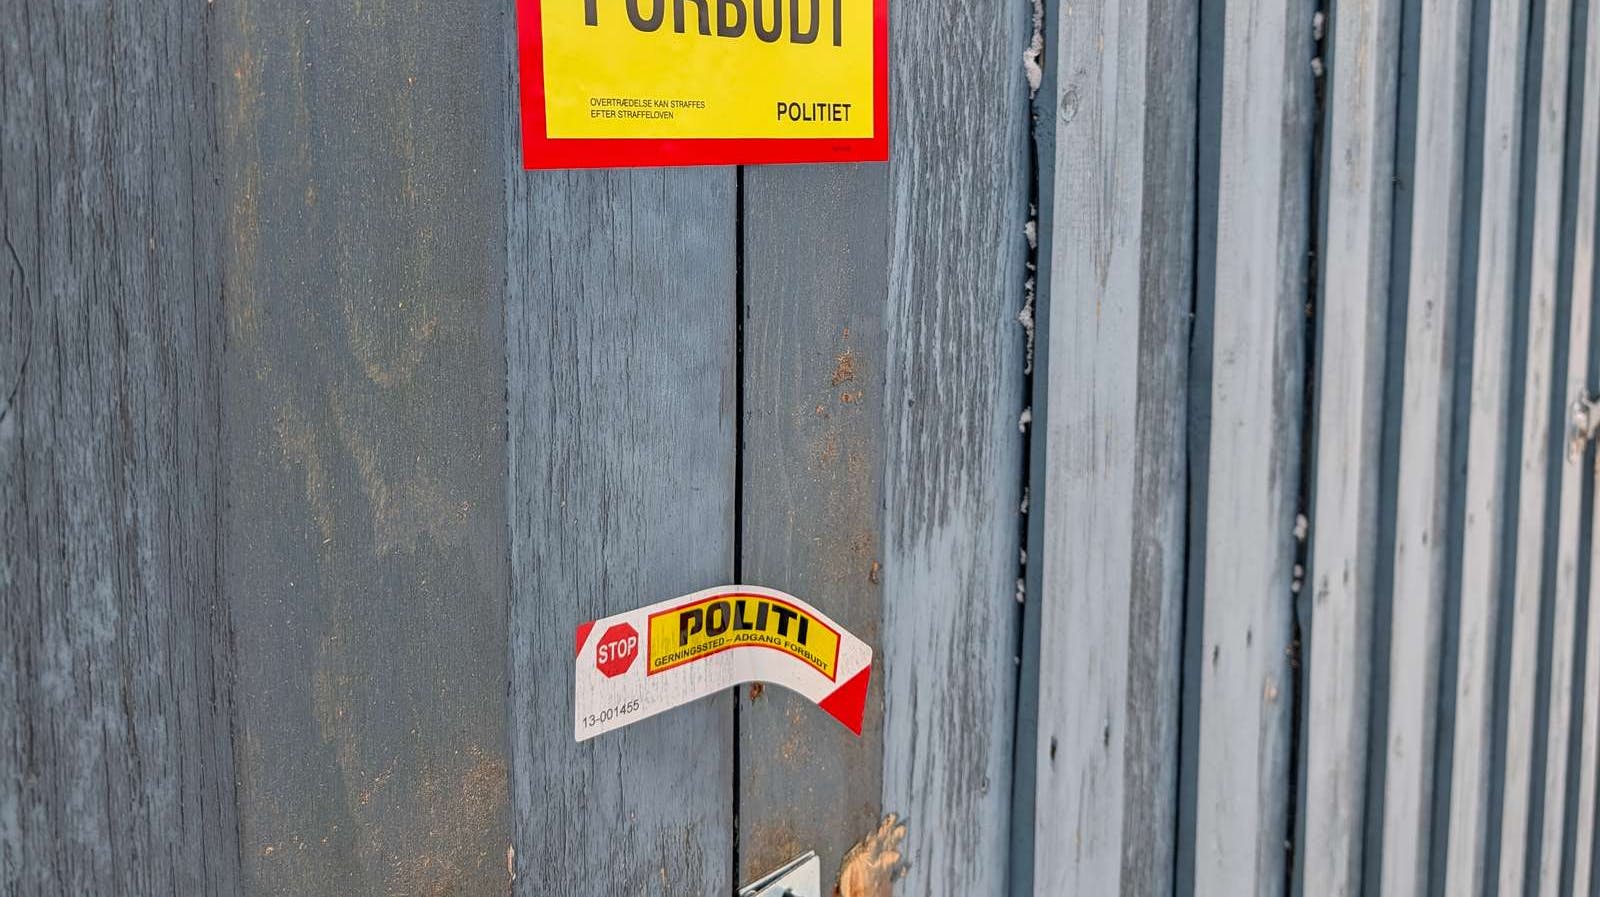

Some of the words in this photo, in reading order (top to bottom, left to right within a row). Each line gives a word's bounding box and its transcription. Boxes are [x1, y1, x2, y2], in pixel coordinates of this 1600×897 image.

[590, 98, 652, 108] OVERTRÆDELSE
[654, 100, 669, 108] KAN
[670, 100, 706, 109] STRAFFES
[590, 109, 616, 118] EFTER
[617, 110, 674, 119] STRAFFELOVEN
[776, 102, 851, 122] POLITIET
[679, 600, 809, 647] POLITI
[598, 636, 636, 664] STOP
[654, 637, 725, 667] GERNINGSSTED
[734, 633, 782, 646] ADGANG
[783, 640, 829, 671] FORBUDT
[582, 699, 640, 729] 13-001455
